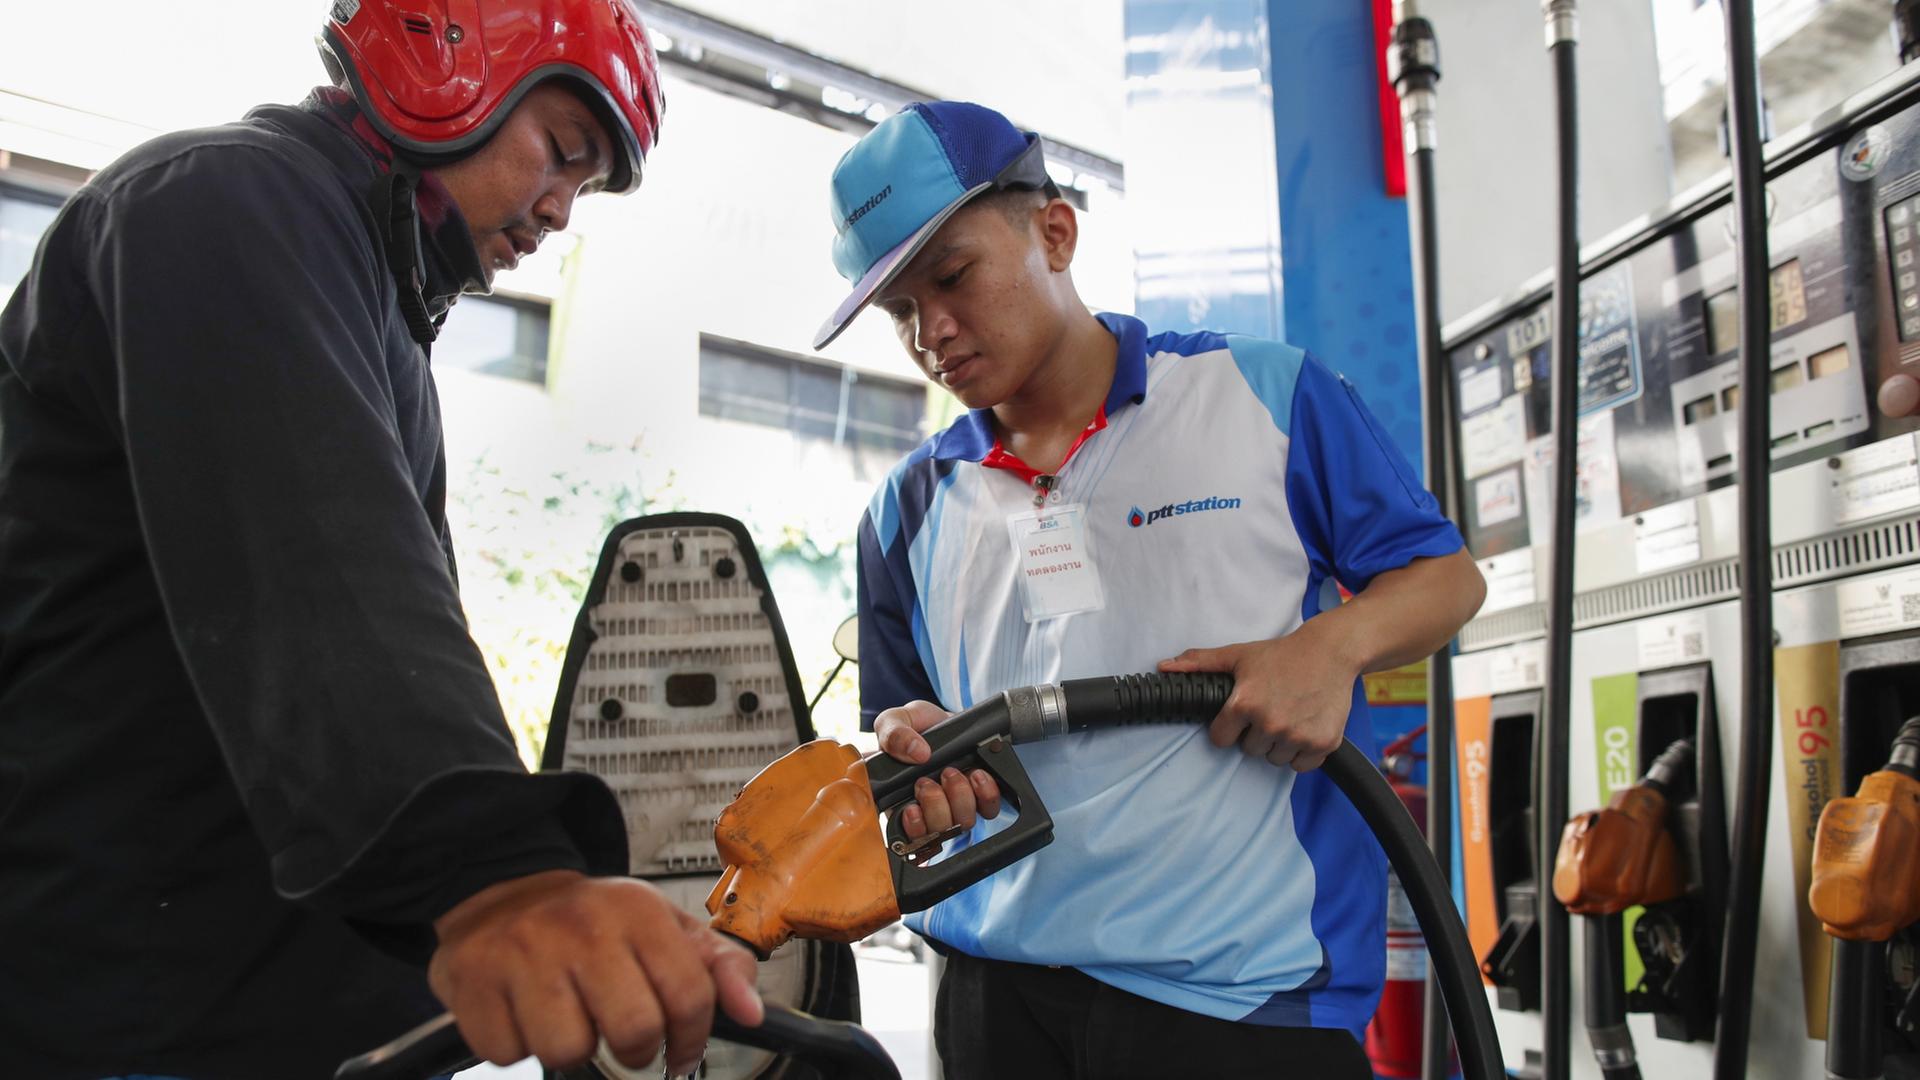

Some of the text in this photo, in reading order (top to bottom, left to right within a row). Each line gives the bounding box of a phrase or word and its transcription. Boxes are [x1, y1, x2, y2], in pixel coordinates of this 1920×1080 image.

[1028, 542, 1073, 558] พนักงาน
[1794, 704, 1831, 756] 95
[1603, 725, 1631, 792] E20
